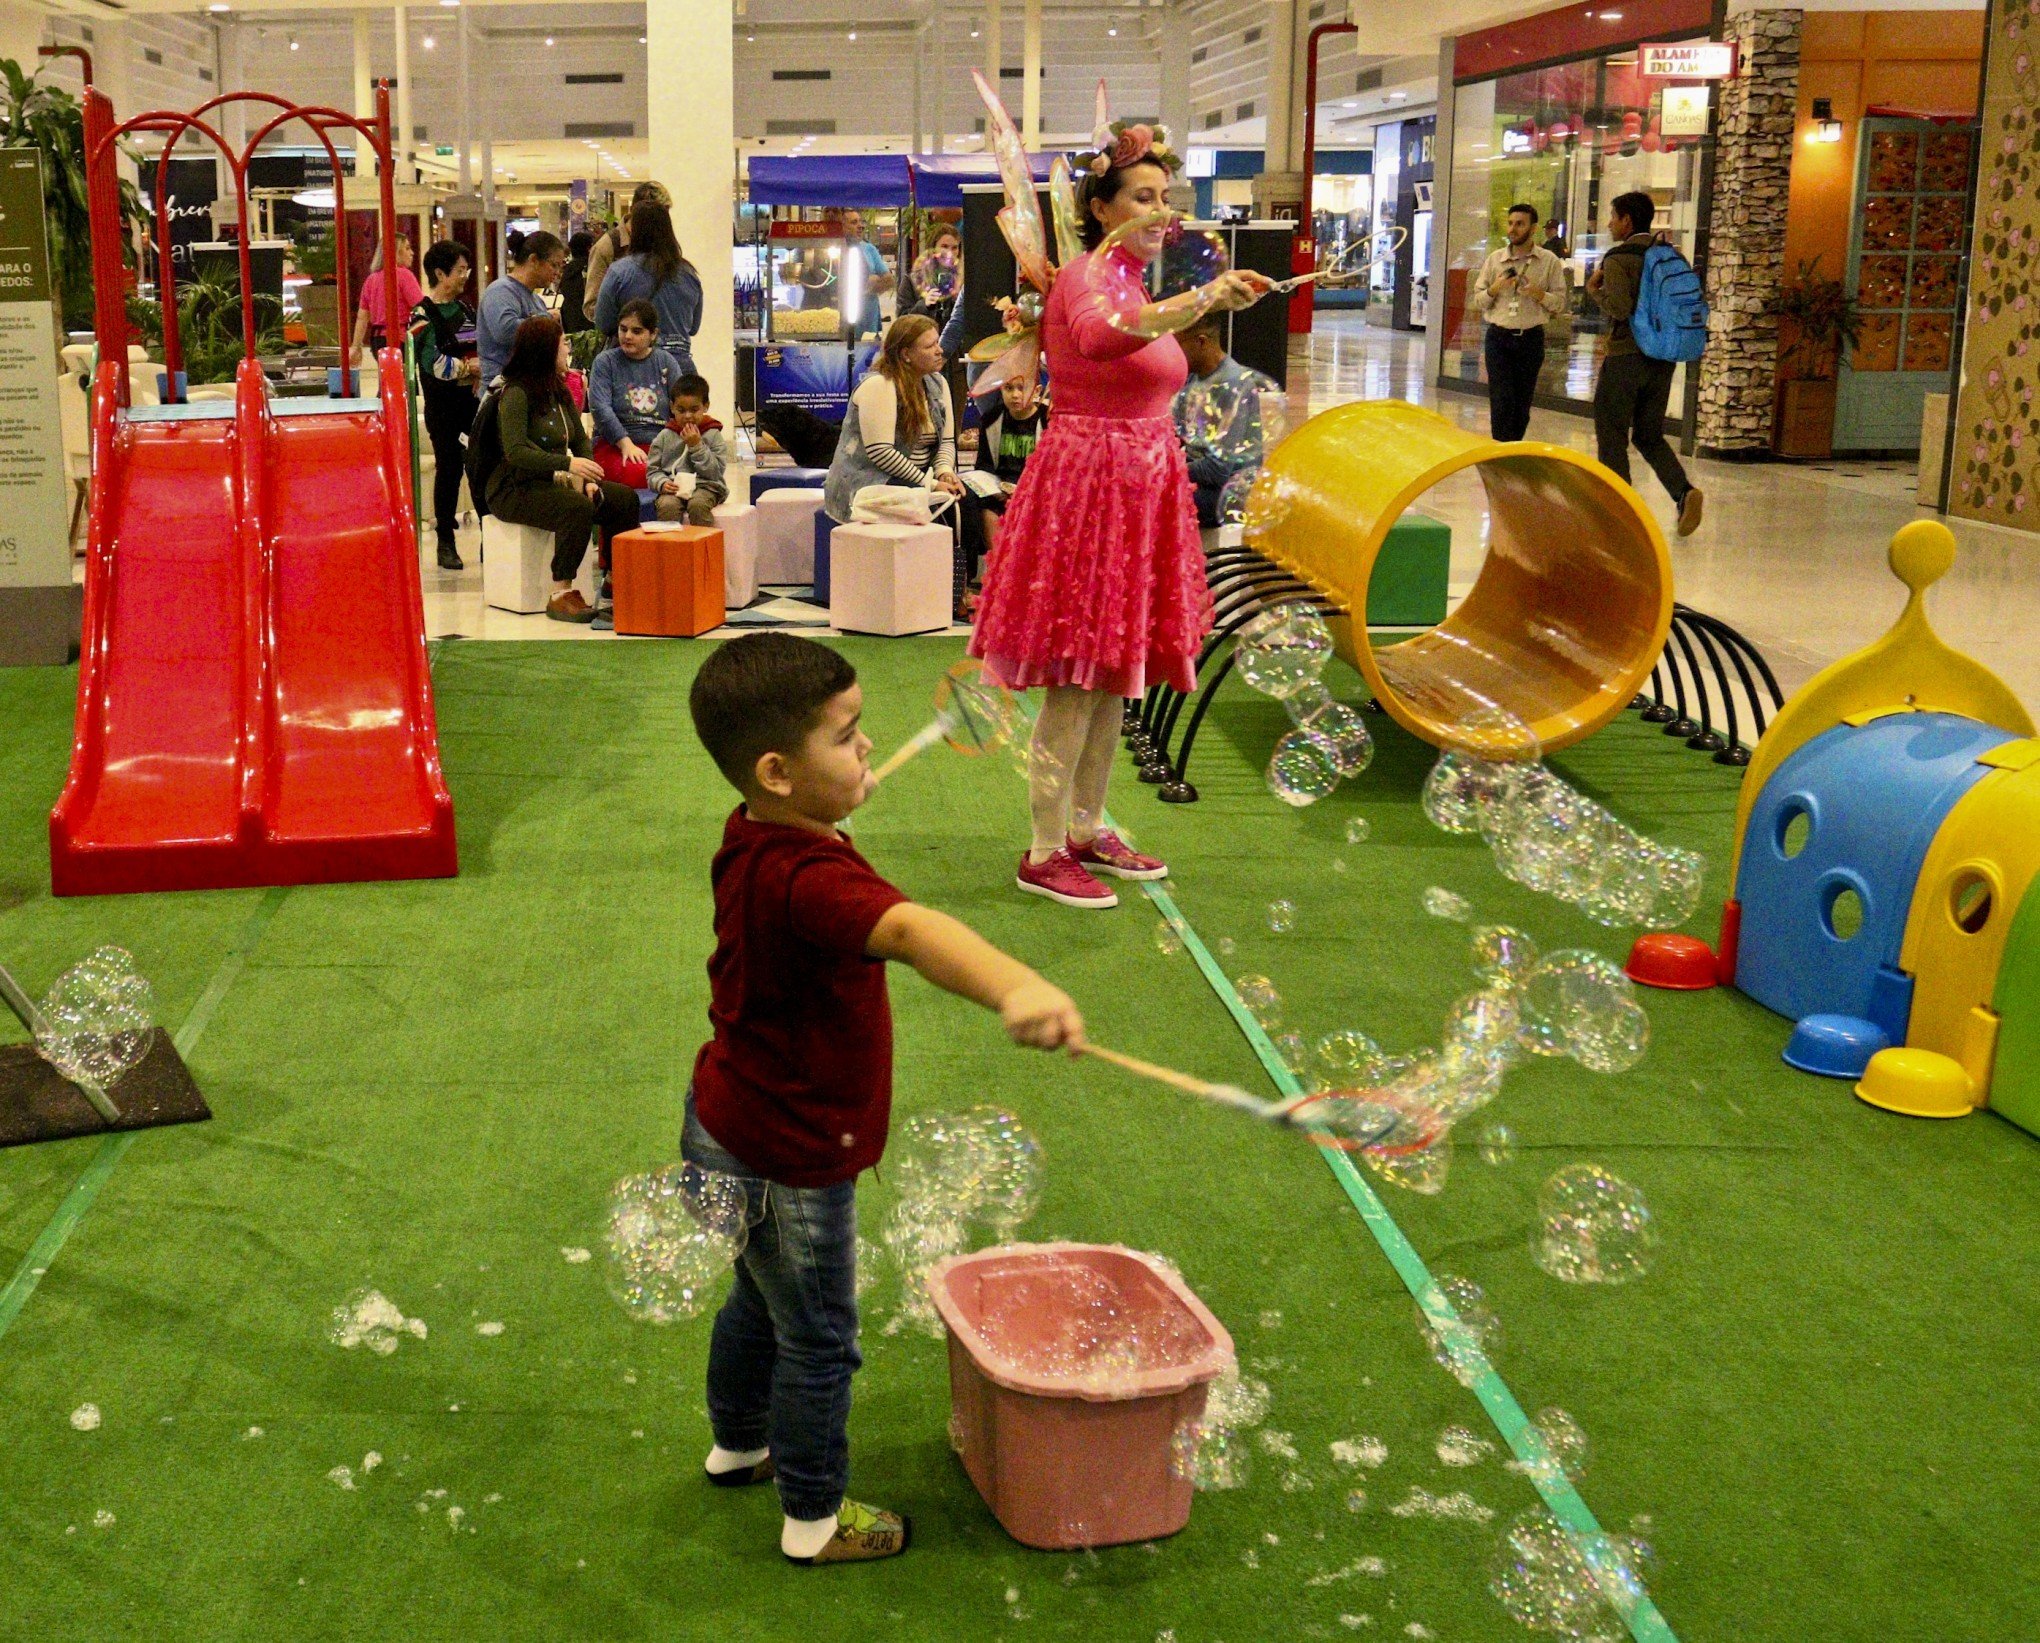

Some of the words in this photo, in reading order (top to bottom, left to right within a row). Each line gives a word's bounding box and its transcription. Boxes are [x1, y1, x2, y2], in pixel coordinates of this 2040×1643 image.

[1650, 62, 1673, 73] DO
[1677, 61, 1700, 73] AM
[787, 224, 826, 234] PIPOCA
[22, 262, 31, 273] O
